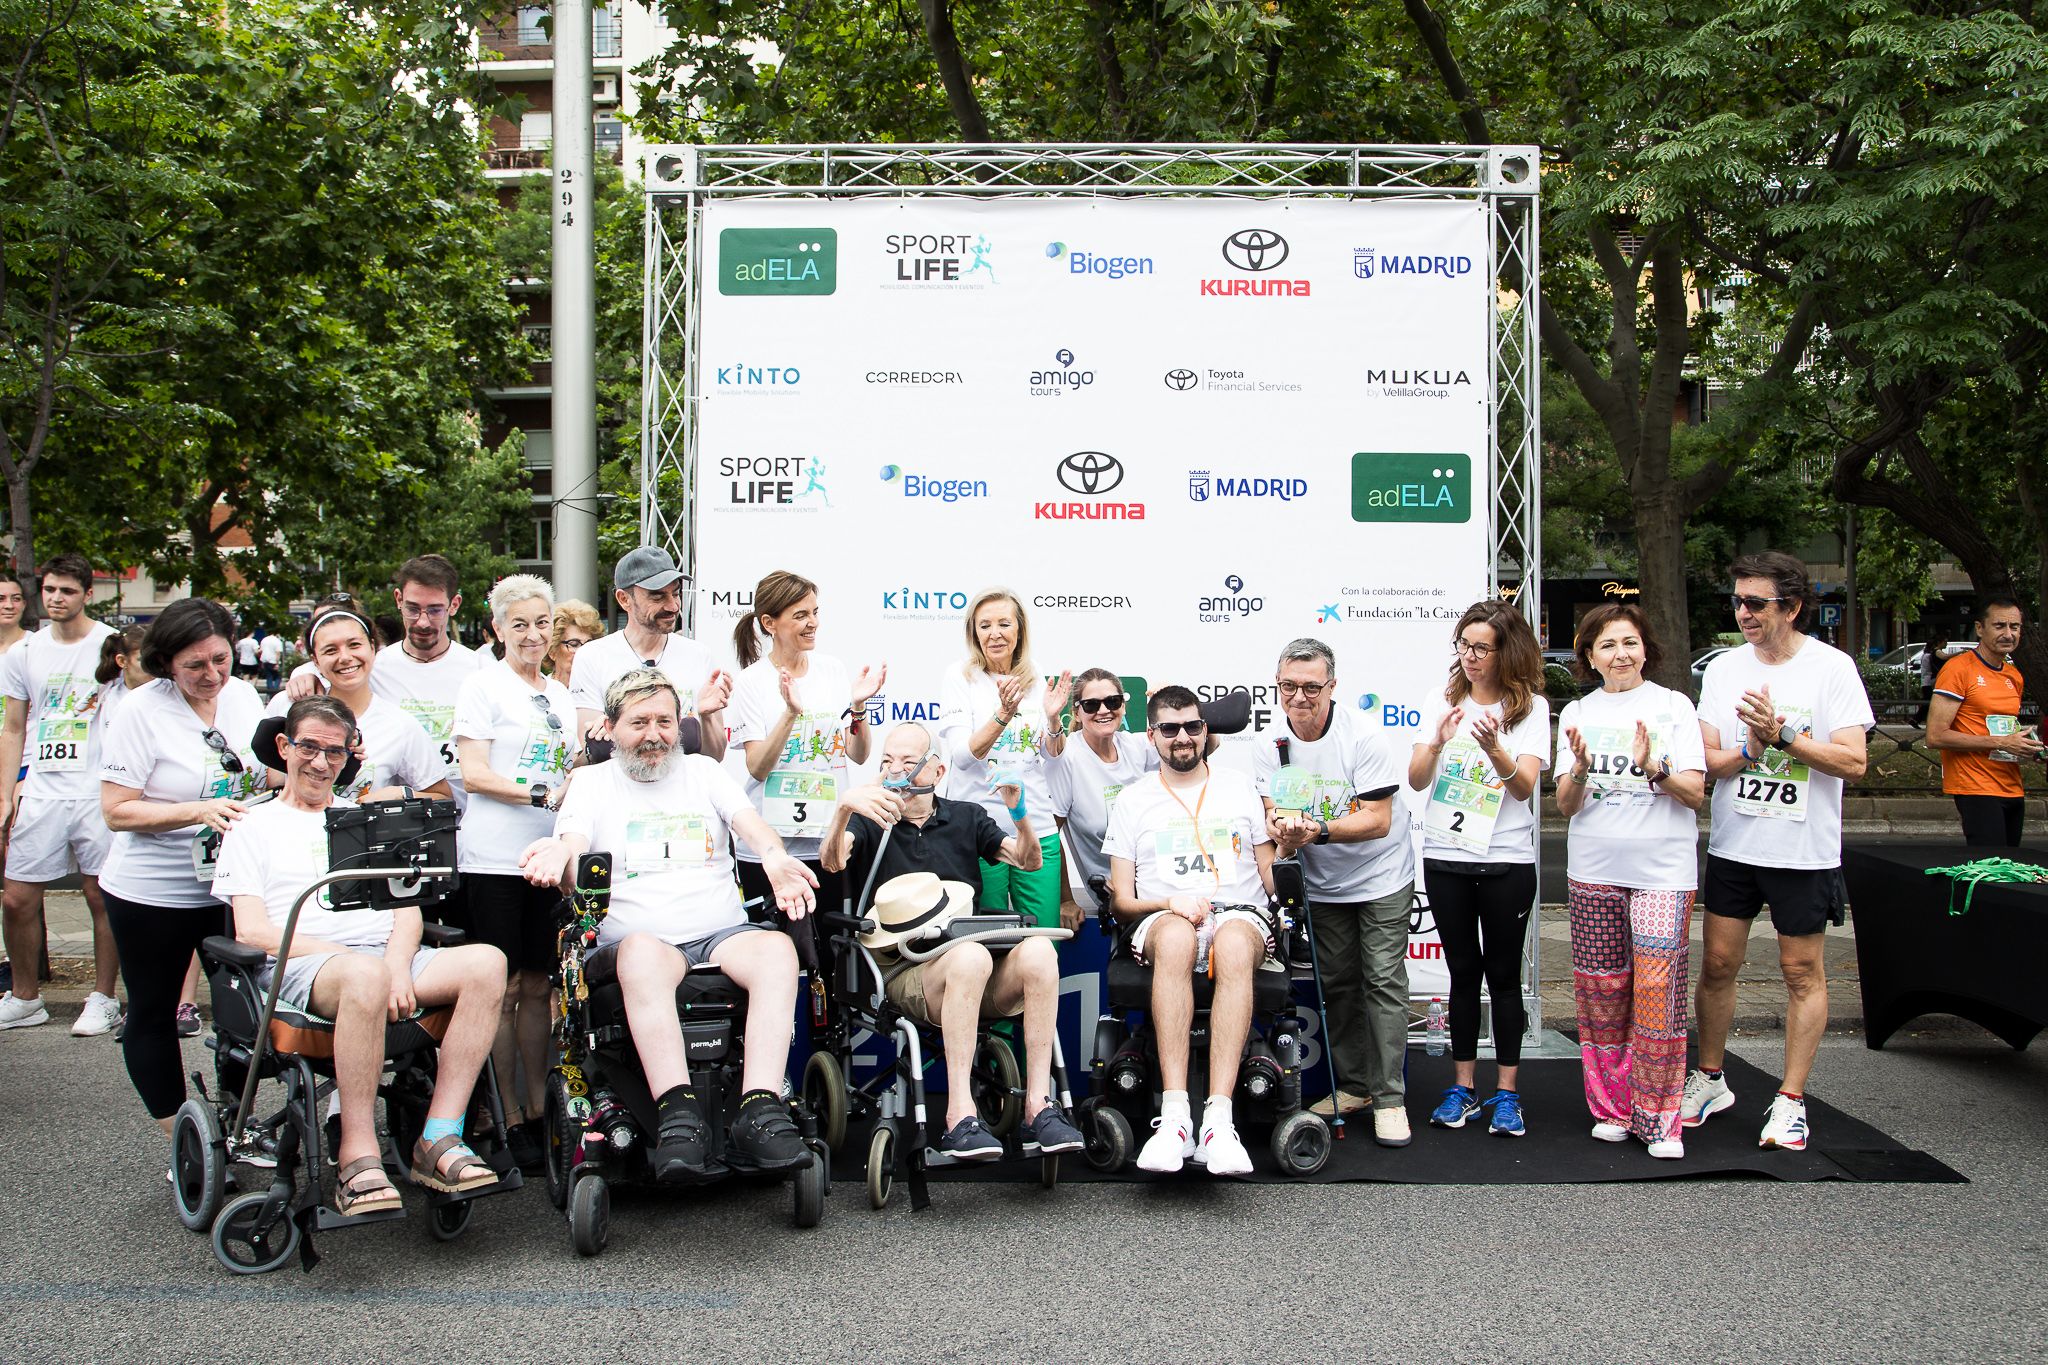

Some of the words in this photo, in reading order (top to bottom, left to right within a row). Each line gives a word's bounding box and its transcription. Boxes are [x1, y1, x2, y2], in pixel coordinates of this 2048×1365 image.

[886, 235, 971, 255] SPORT
[736, 257, 820, 282] adELA
[898, 259, 959, 281] LIFE
[1070, 252, 1153, 280] Biogen
[1381, 256, 1471, 279] MADRID
[1030, 371, 1093, 390] amigo
[1208, 369, 1244, 381] Toyota
[1368, 370, 1471, 385] MUKUA
[744, 389, 768, 397] Mobility
[1030, 386, 1061, 396] tours
[1208, 382, 1255, 392] Financial
[1258, 382, 1302, 392] Services
[720, 457, 805, 477] SPORT
[732, 481, 793, 504] LIFE
[904, 474, 988, 502] Biogen
[1217, 478, 1307, 501] MADRID
[1368, 484, 1454, 508] adELA
[1341, 586, 1360, 596] Con
[1362, 586, 1370, 596] la
[1372, 586, 1430, 597] colaboración
[1431, 586, 1446, 597] de:
[1199, 598, 1263, 617] amigo
[1199, 612, 1230, 623] tours
[1348, 605, 1412, 619] Fundación
[891, 702, 940, 721] MAD
[1384, 704, 1421, 732] Bio
[39, 743, 78, 760] 1281
[1737, 777, 1798, 805] 1278
[792, 802, 807, 823] 3
[1450, 811, 1464, 833] 2
[662, 841, 671, 858] 1
[1174, 854, 1218, 875] 341
[691, 1038, 722, 1050] permobil
